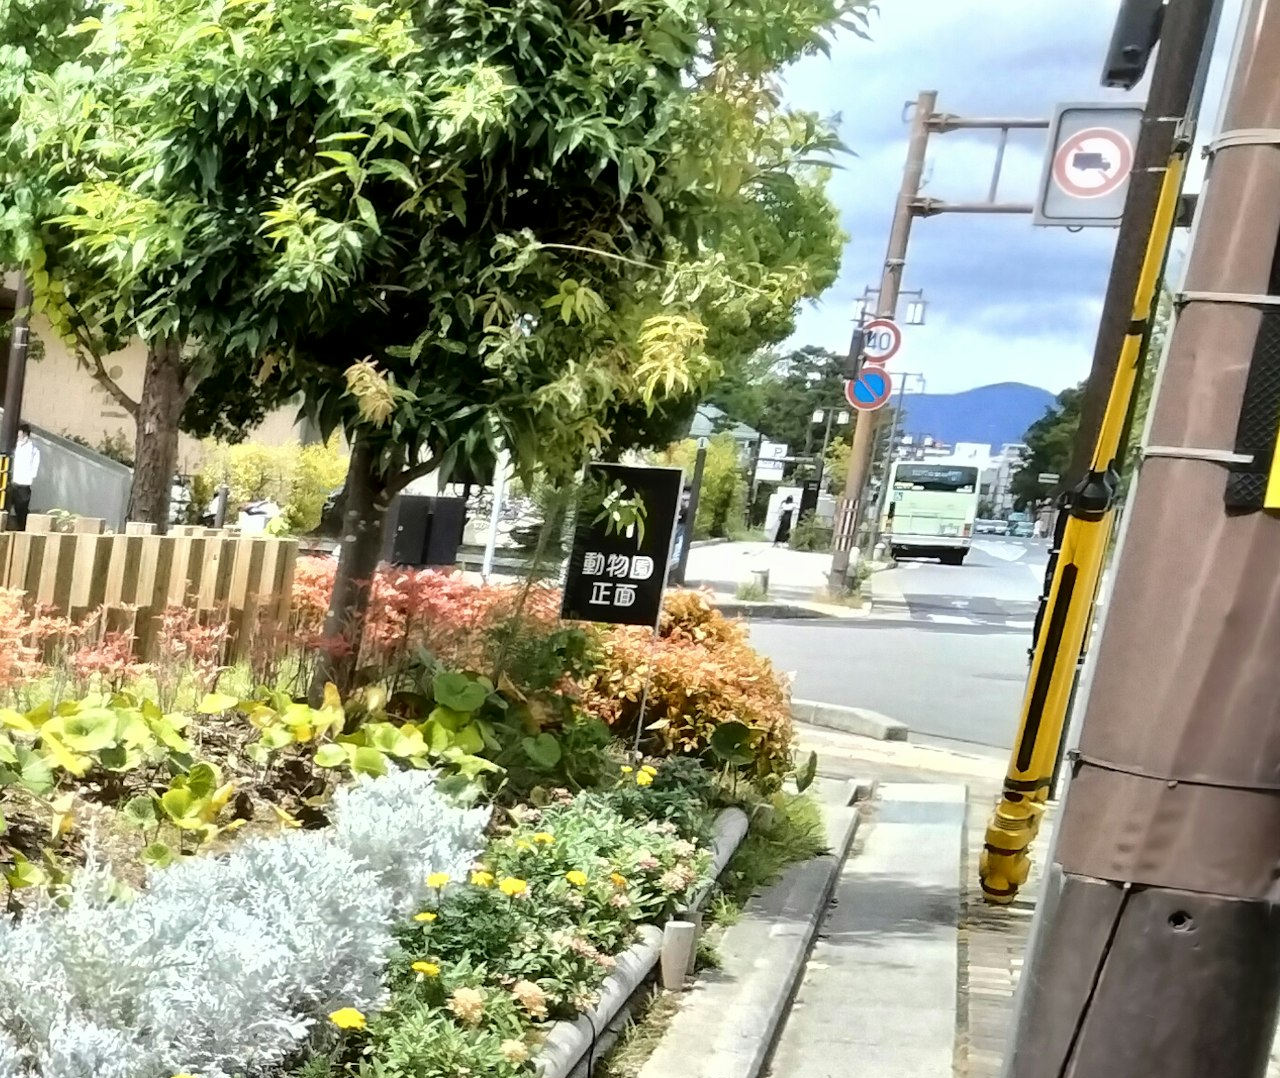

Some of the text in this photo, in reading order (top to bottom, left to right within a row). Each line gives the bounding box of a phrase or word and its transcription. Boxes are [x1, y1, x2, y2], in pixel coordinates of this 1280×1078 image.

[866, 332, 892, 351] 40
[581, 551, 654, 580] 動物園
[588, 582, 639, 607] 正面
